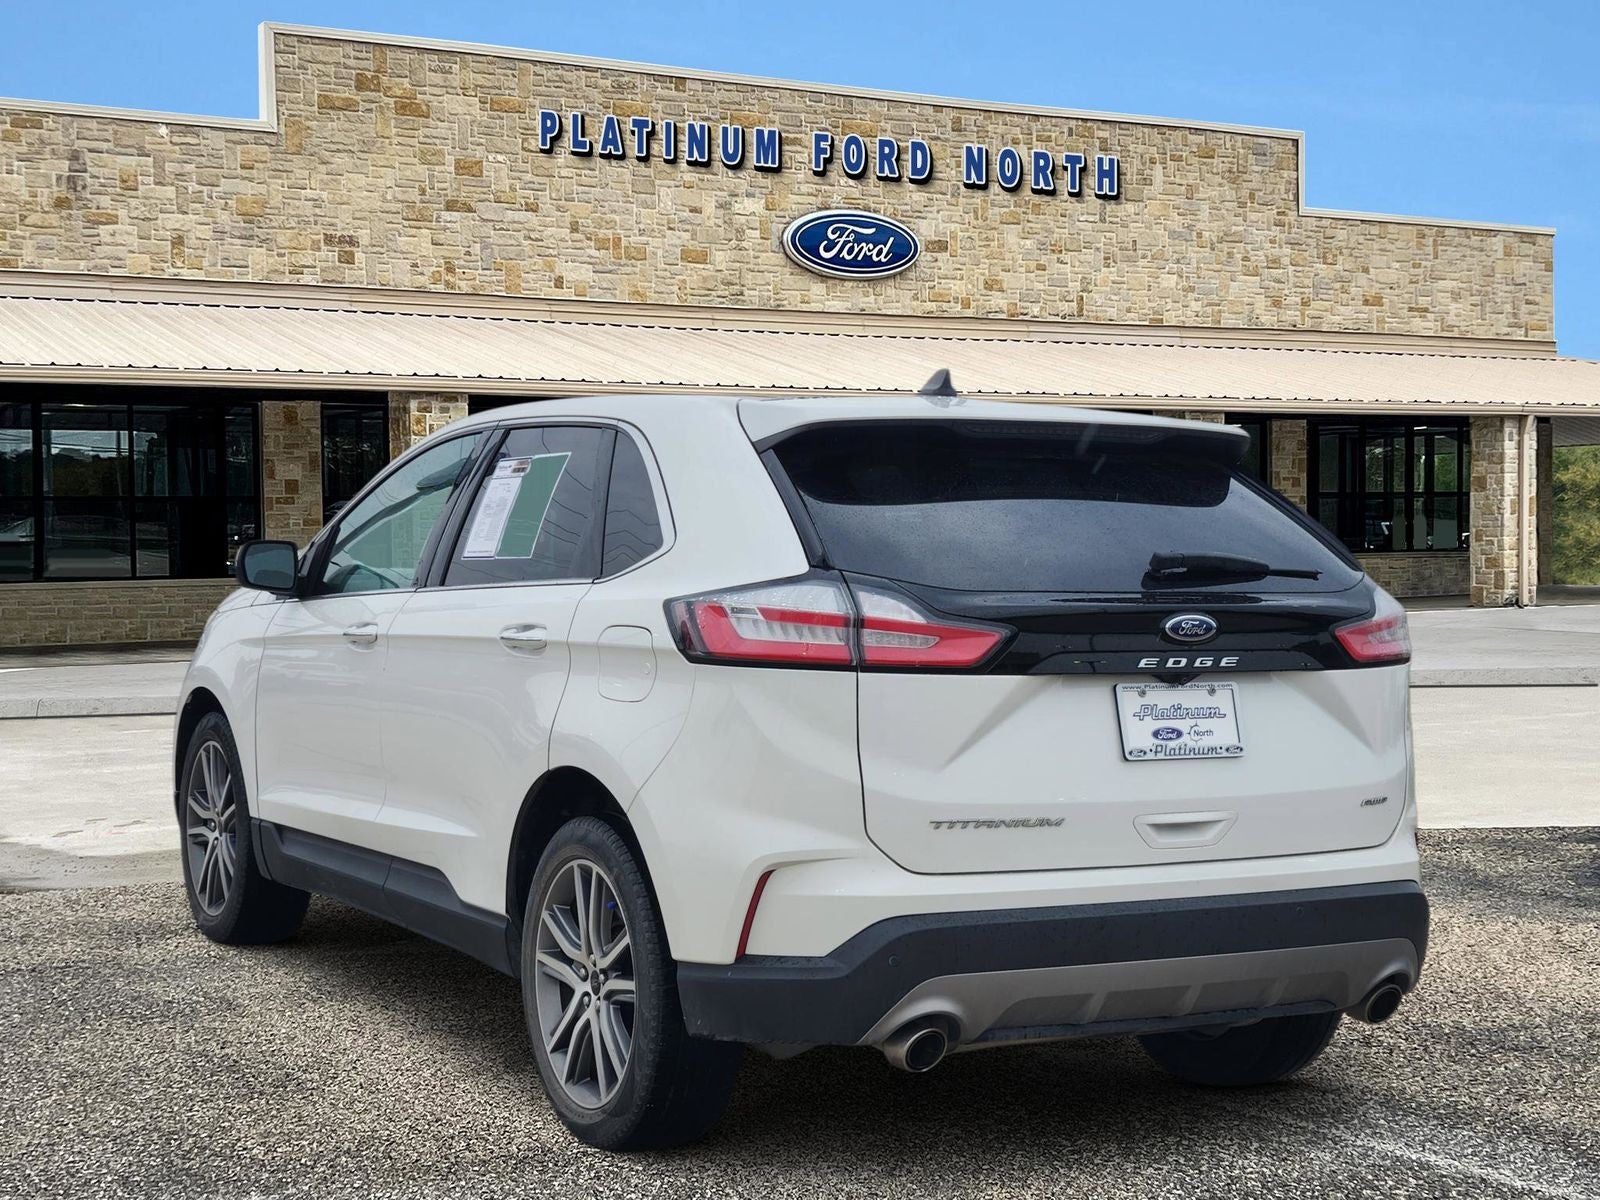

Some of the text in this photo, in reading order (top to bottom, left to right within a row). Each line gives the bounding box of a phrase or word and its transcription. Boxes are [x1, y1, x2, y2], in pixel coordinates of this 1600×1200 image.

[538, 109, 1120, 199] PLATINUM FORD NORTH
[818, 222, 895, 264] Ford
[1179, 620, 1207, 635] Ford
[1137, 656, 1240, 668] EDGE
[1132, 703, 1227, 721] Platinum
[1157, 729, 1214, 740] Ford North
[1154, 743, 1223, 757] Platinum
[929, 817, 1066, 830] TITANIUM
